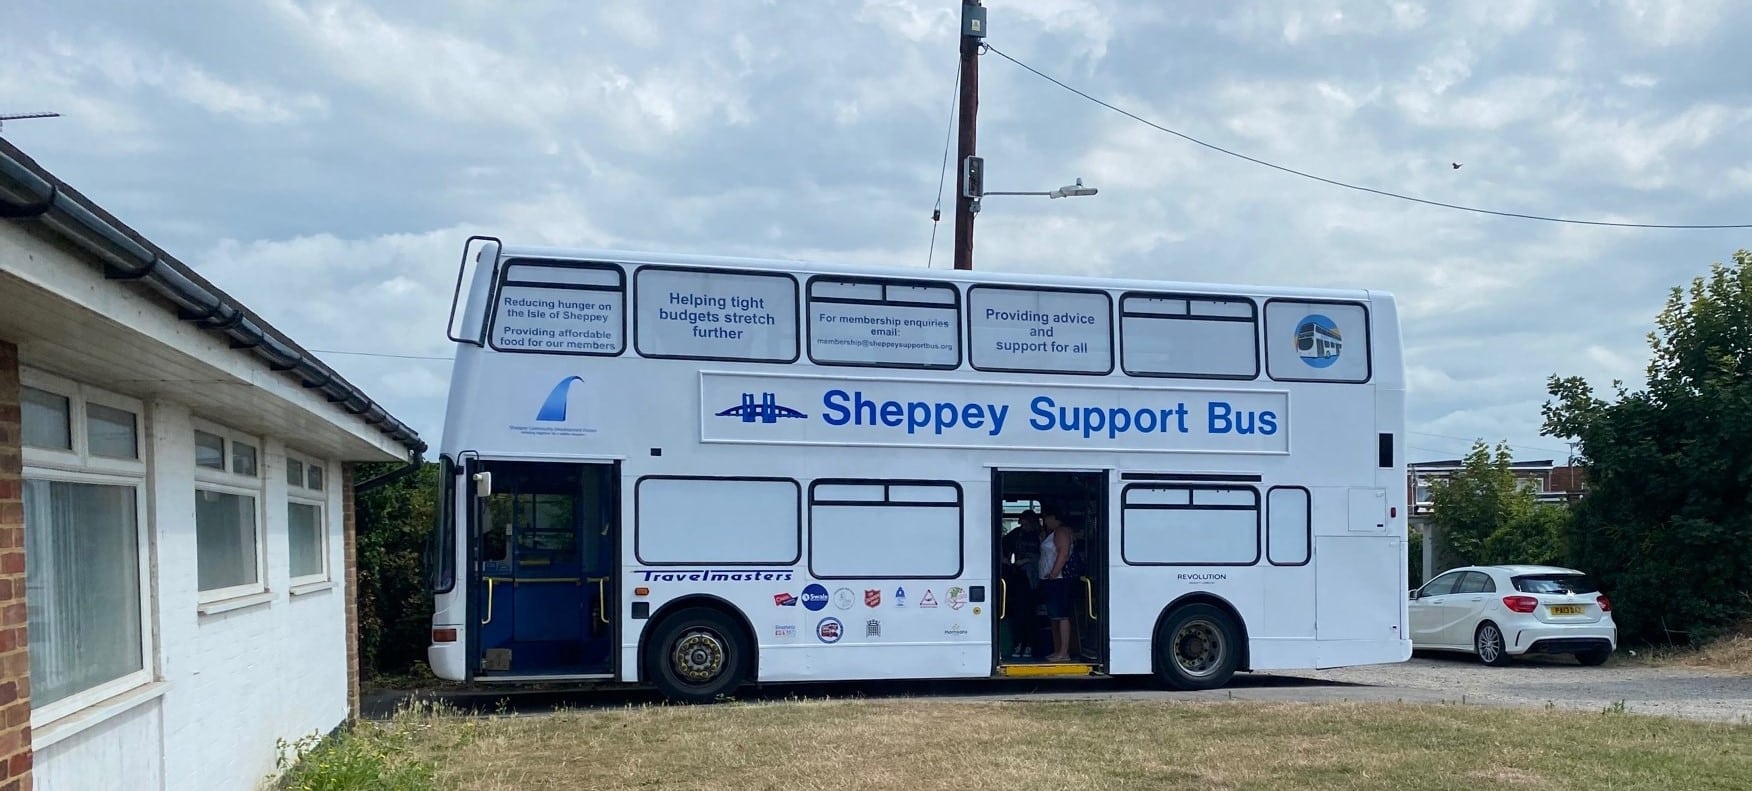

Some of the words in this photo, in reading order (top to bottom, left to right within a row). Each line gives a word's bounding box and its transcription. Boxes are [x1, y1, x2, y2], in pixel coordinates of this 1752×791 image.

[504, 297, 555, 309] Reducing
[557, 300, 596, 312] hunger
[598, 303, 612, 311] on
[669, 292, 726, 309] Helping
[731, 295, 765, 312] tight
[507, 308, 525, 318] the
[527, 309, 546, 319] Isle
[548, 310, 561, 319] of
[562, 312, 609, 324] Sheppey
[659, 308, 719, 323] budgets
[724, 311, 775, 325] stretch
[819, 313, 837, 323] For
[839, 315, 902, 327] membership
[903, 319, 949, 330] enquiries
[985, 308, 1049, 325] Providing
[1052, 312, 1095, 325] advice
[503, 326, 556, 338] Providing
[558, 328, 612, 340] affordable
[692, 325, 744, 340] further
[870, 327, 901, 337] email:
[1029, 326, 1054, 338] and
[500, 337, 525, 347] food
[527, 337, 543, 347] for
[545, 340, 565, 348] our
[566, 340, 616, 350] members
[816, 337, 953, 352] membership@sheppeysupportbus.org
[996, 340, 1048, 355] support
[1050, 341, 1070, 353] for
[1072, 342, 1088, 354] all
[822, 390, 1010, 436] Sheppey
[1029, 396, 1189, 439] Support
[1207, 402, 1278, 436] Bus
[633, 569, 794, 582] Travelmasters
